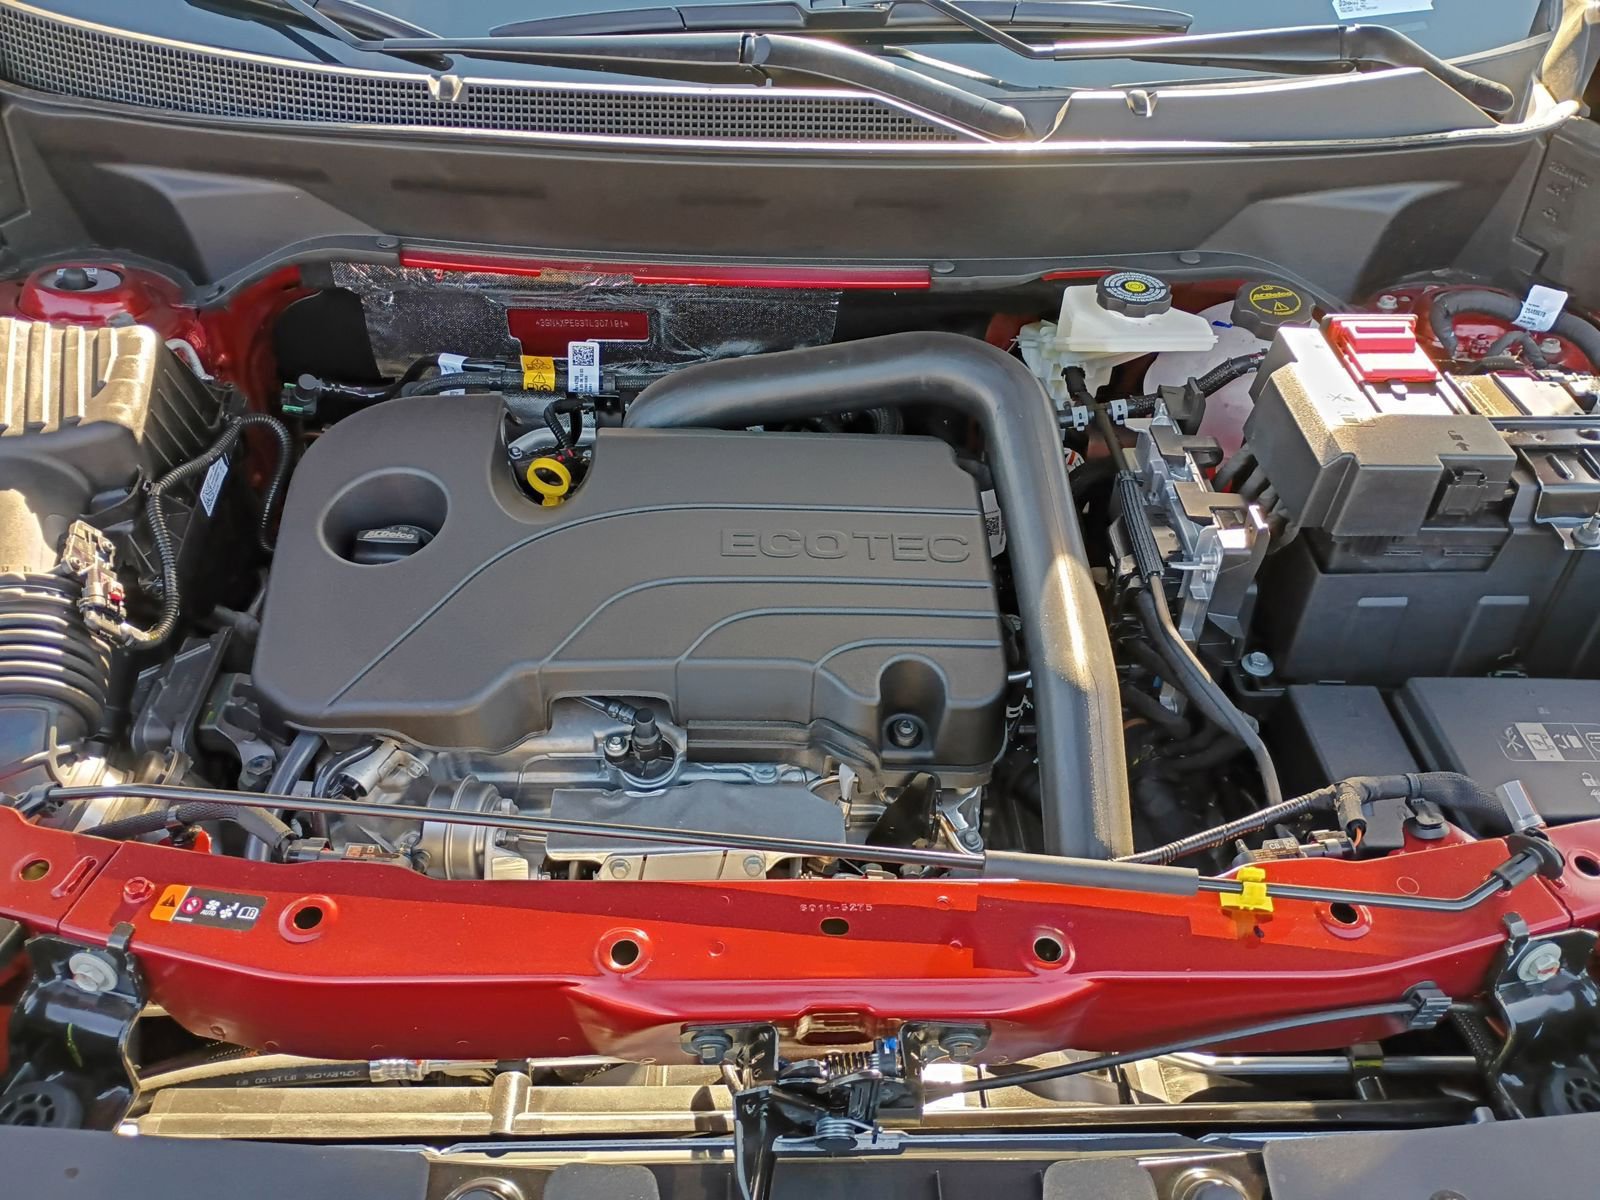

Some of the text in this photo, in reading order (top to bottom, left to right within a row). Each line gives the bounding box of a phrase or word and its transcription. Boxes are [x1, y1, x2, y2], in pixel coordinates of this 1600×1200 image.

[362, 530, 415, 539] ACDelco
[720, 530, 971, 564] ECOTEC
[200, 909, 217, 917] AUTO
